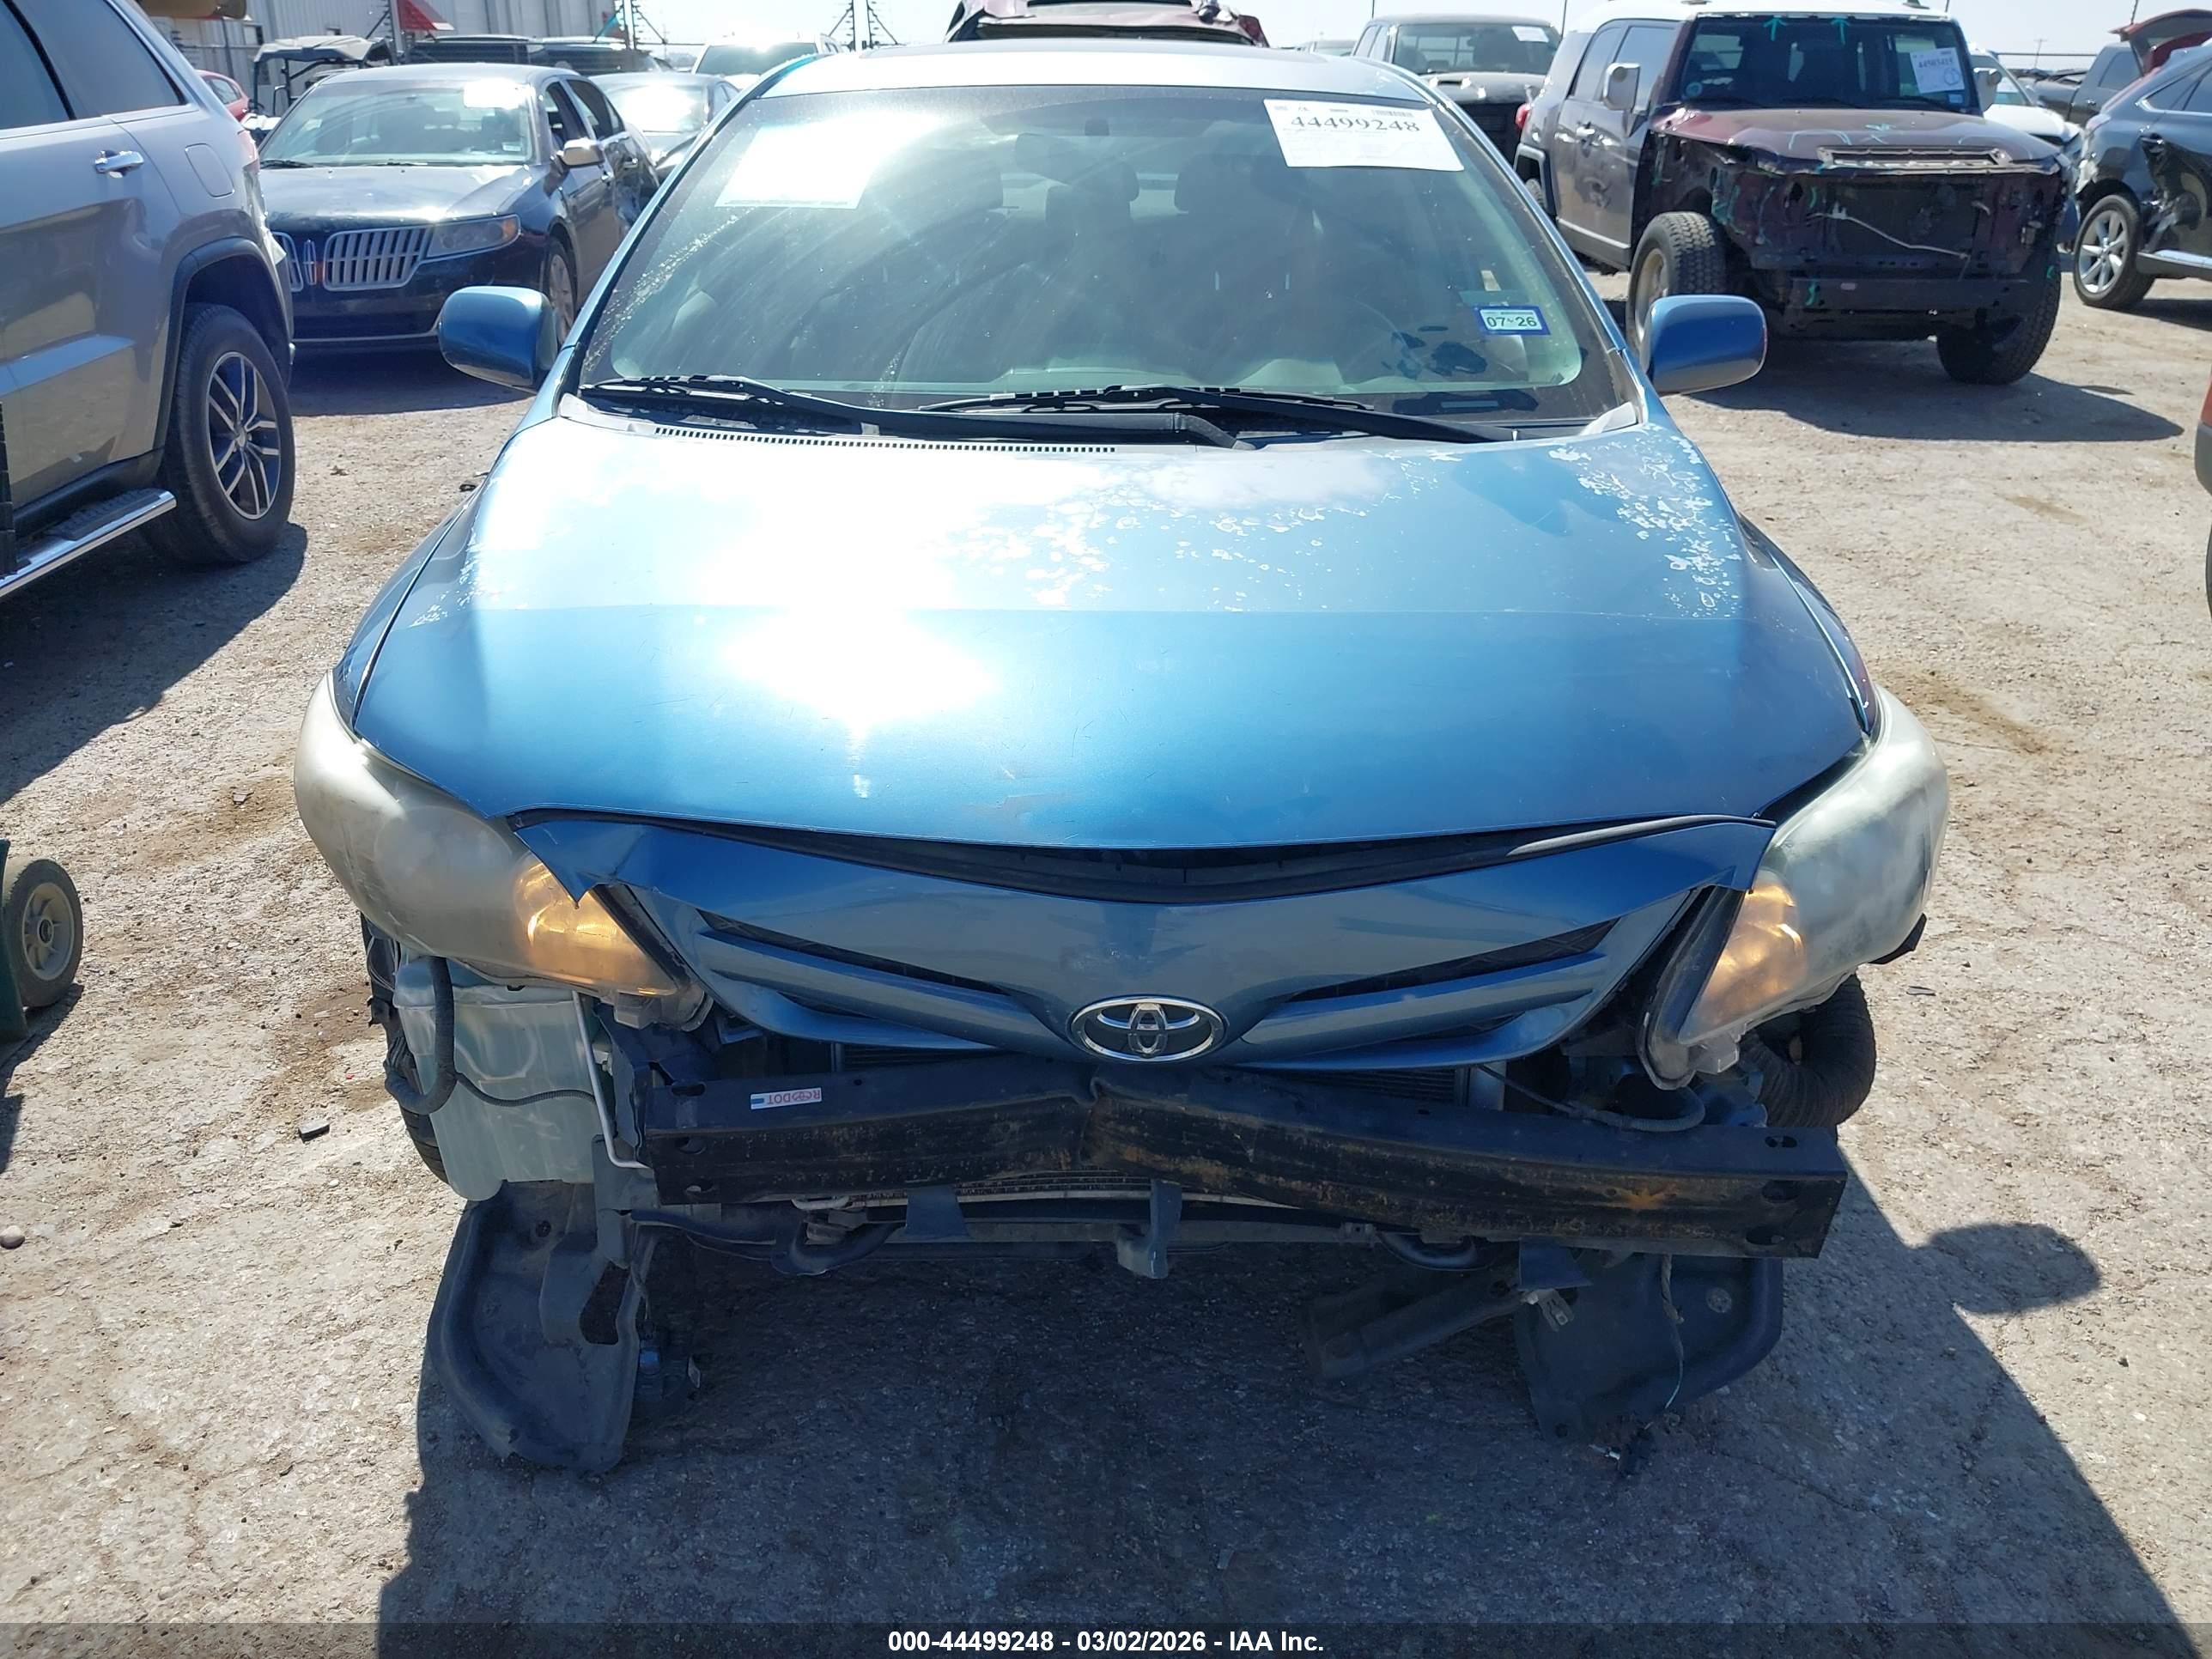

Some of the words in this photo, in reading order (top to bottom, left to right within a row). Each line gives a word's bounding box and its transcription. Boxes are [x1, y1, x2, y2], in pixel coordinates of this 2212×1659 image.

[1291, 116, 1421, 132] 44499248
[1486, 316, 1505, 327] 07
[1515, 316, 1538, 327] 26
